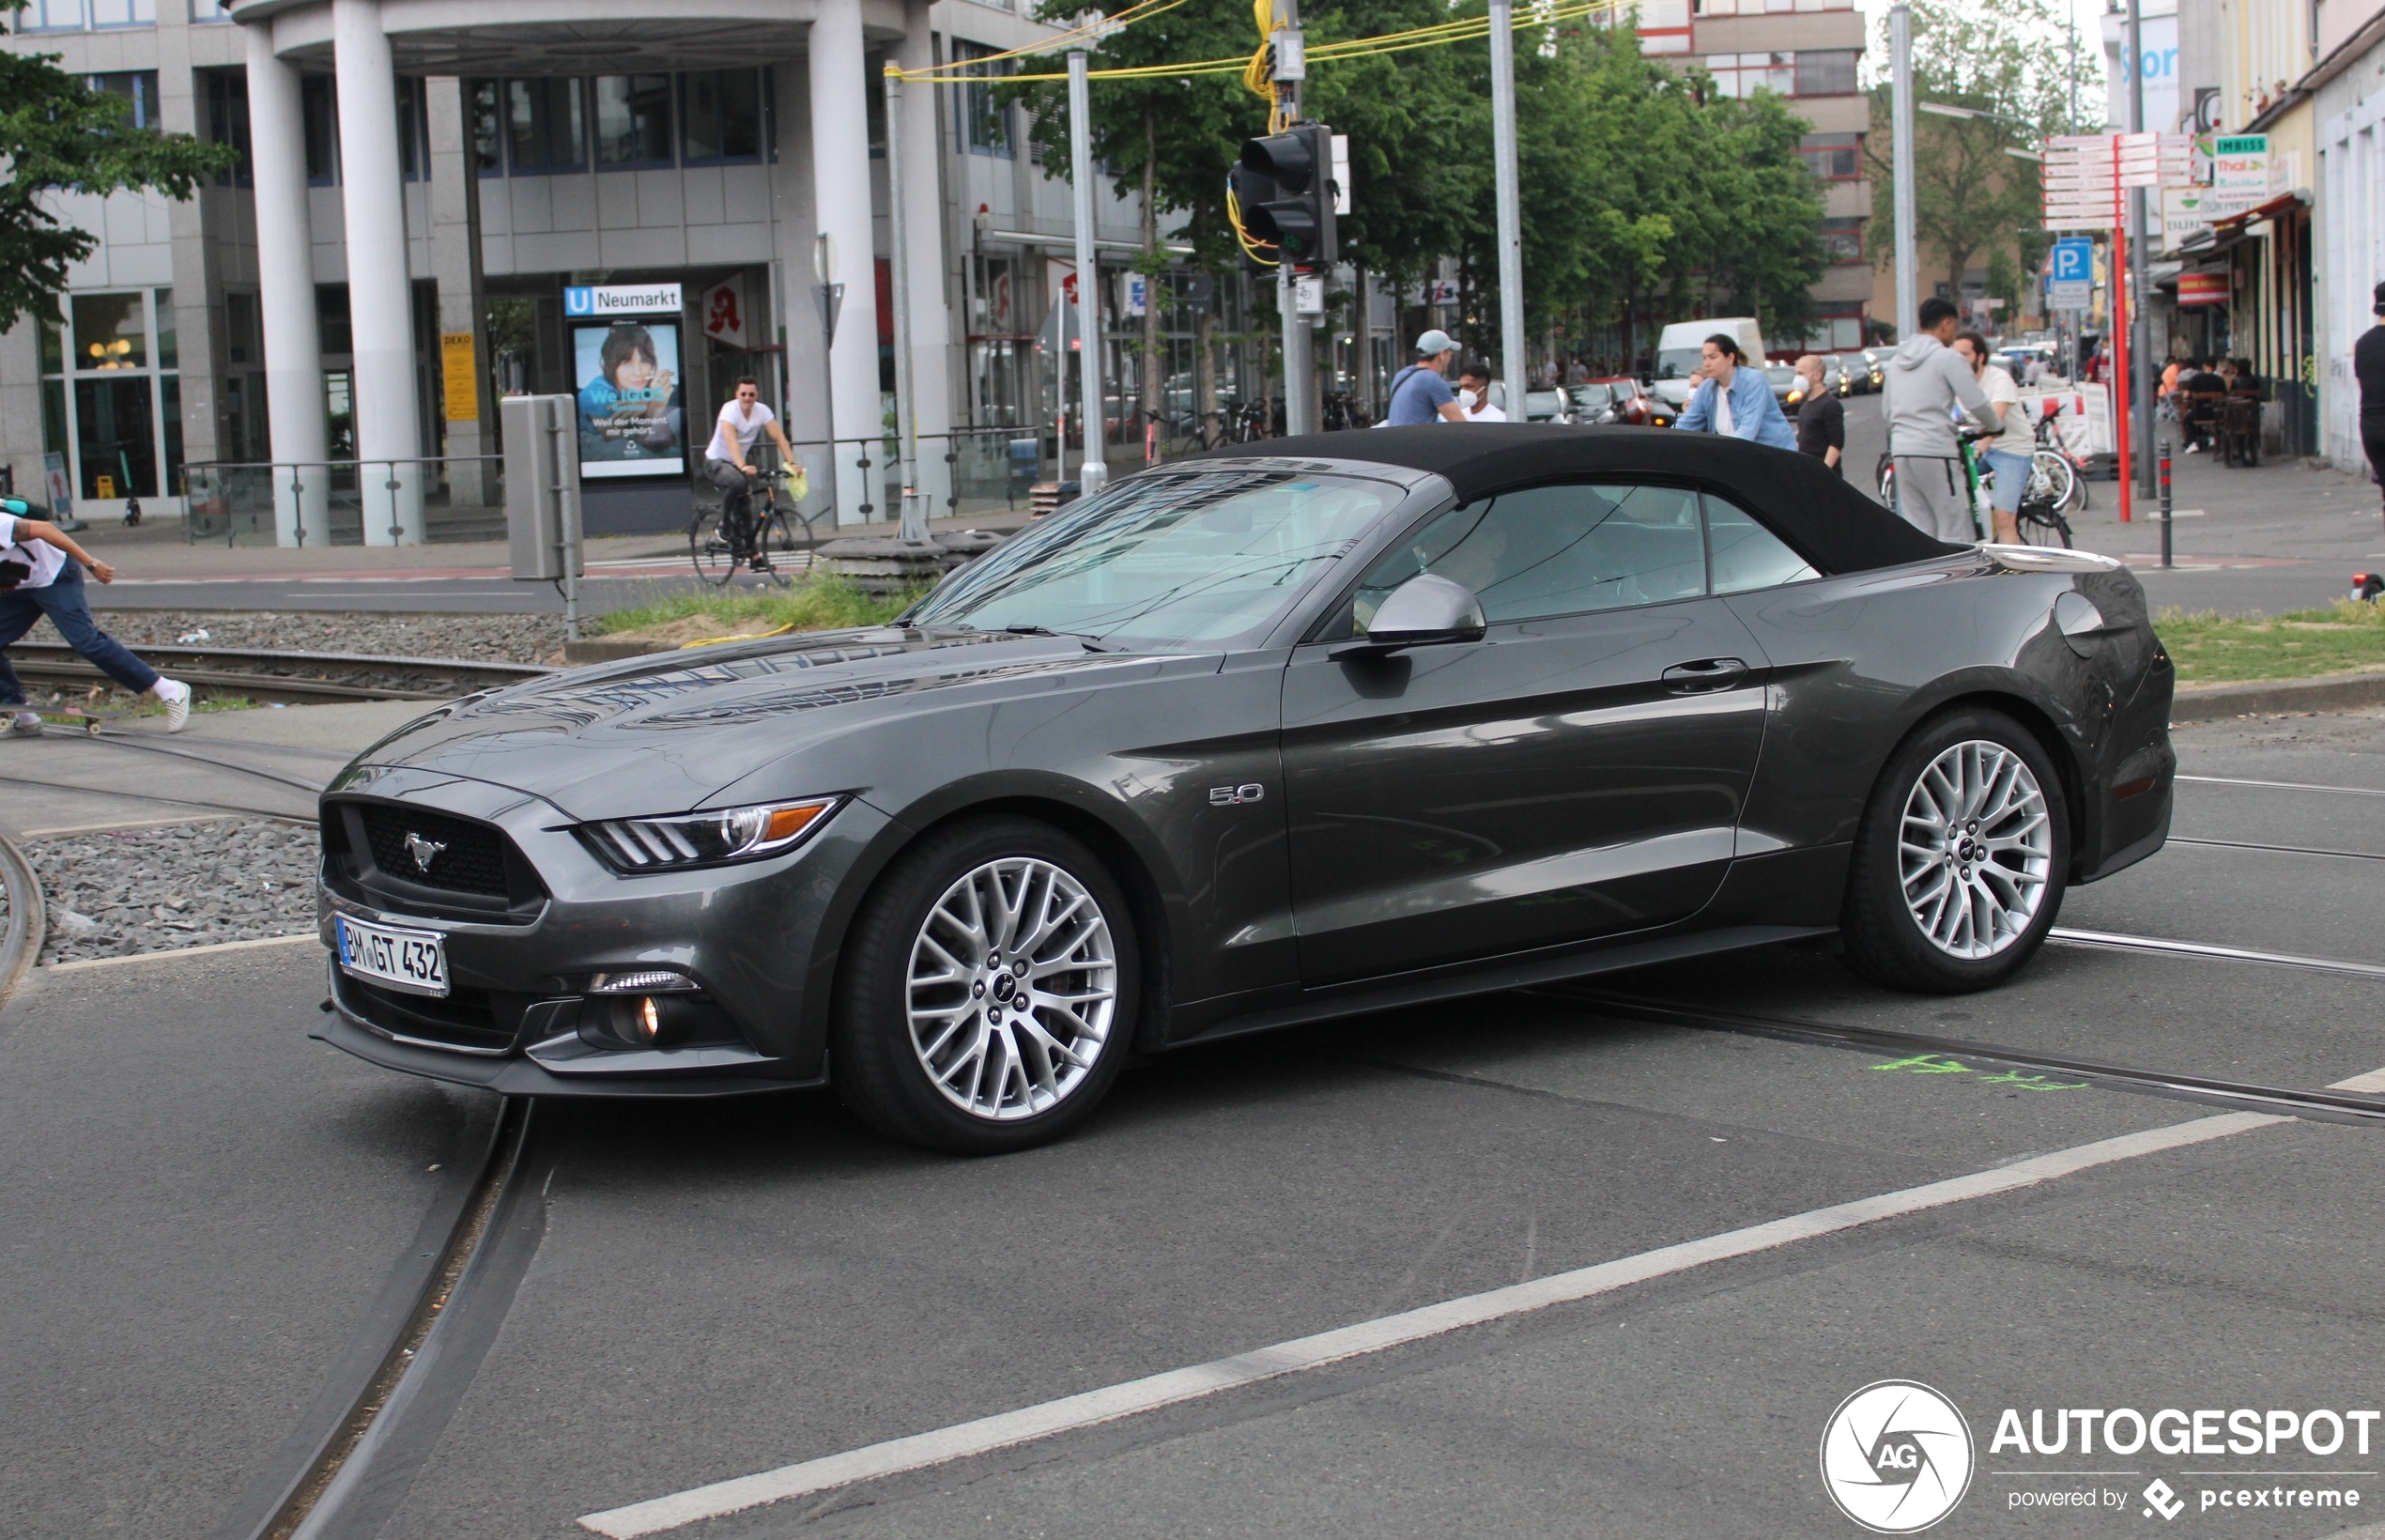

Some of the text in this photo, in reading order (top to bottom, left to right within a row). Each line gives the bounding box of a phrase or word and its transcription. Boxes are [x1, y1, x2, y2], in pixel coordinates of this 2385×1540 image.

[2217, 137, 2265, 153] IMBISS
[2217, 160, 2247, 172] Thai
[2058, 249, 2079, 278] P
[569, 289, 677, 313] U Neumarkt
[590, 389, 618, 405] We
[592, 418, 613, 426] Weil
[631, 416, 668, 425] Moment
[606, 427, 622, 437] mir
[1209, 783, 1265, 806] 5.0
[345, 925, 442, 982] BM GT 432
